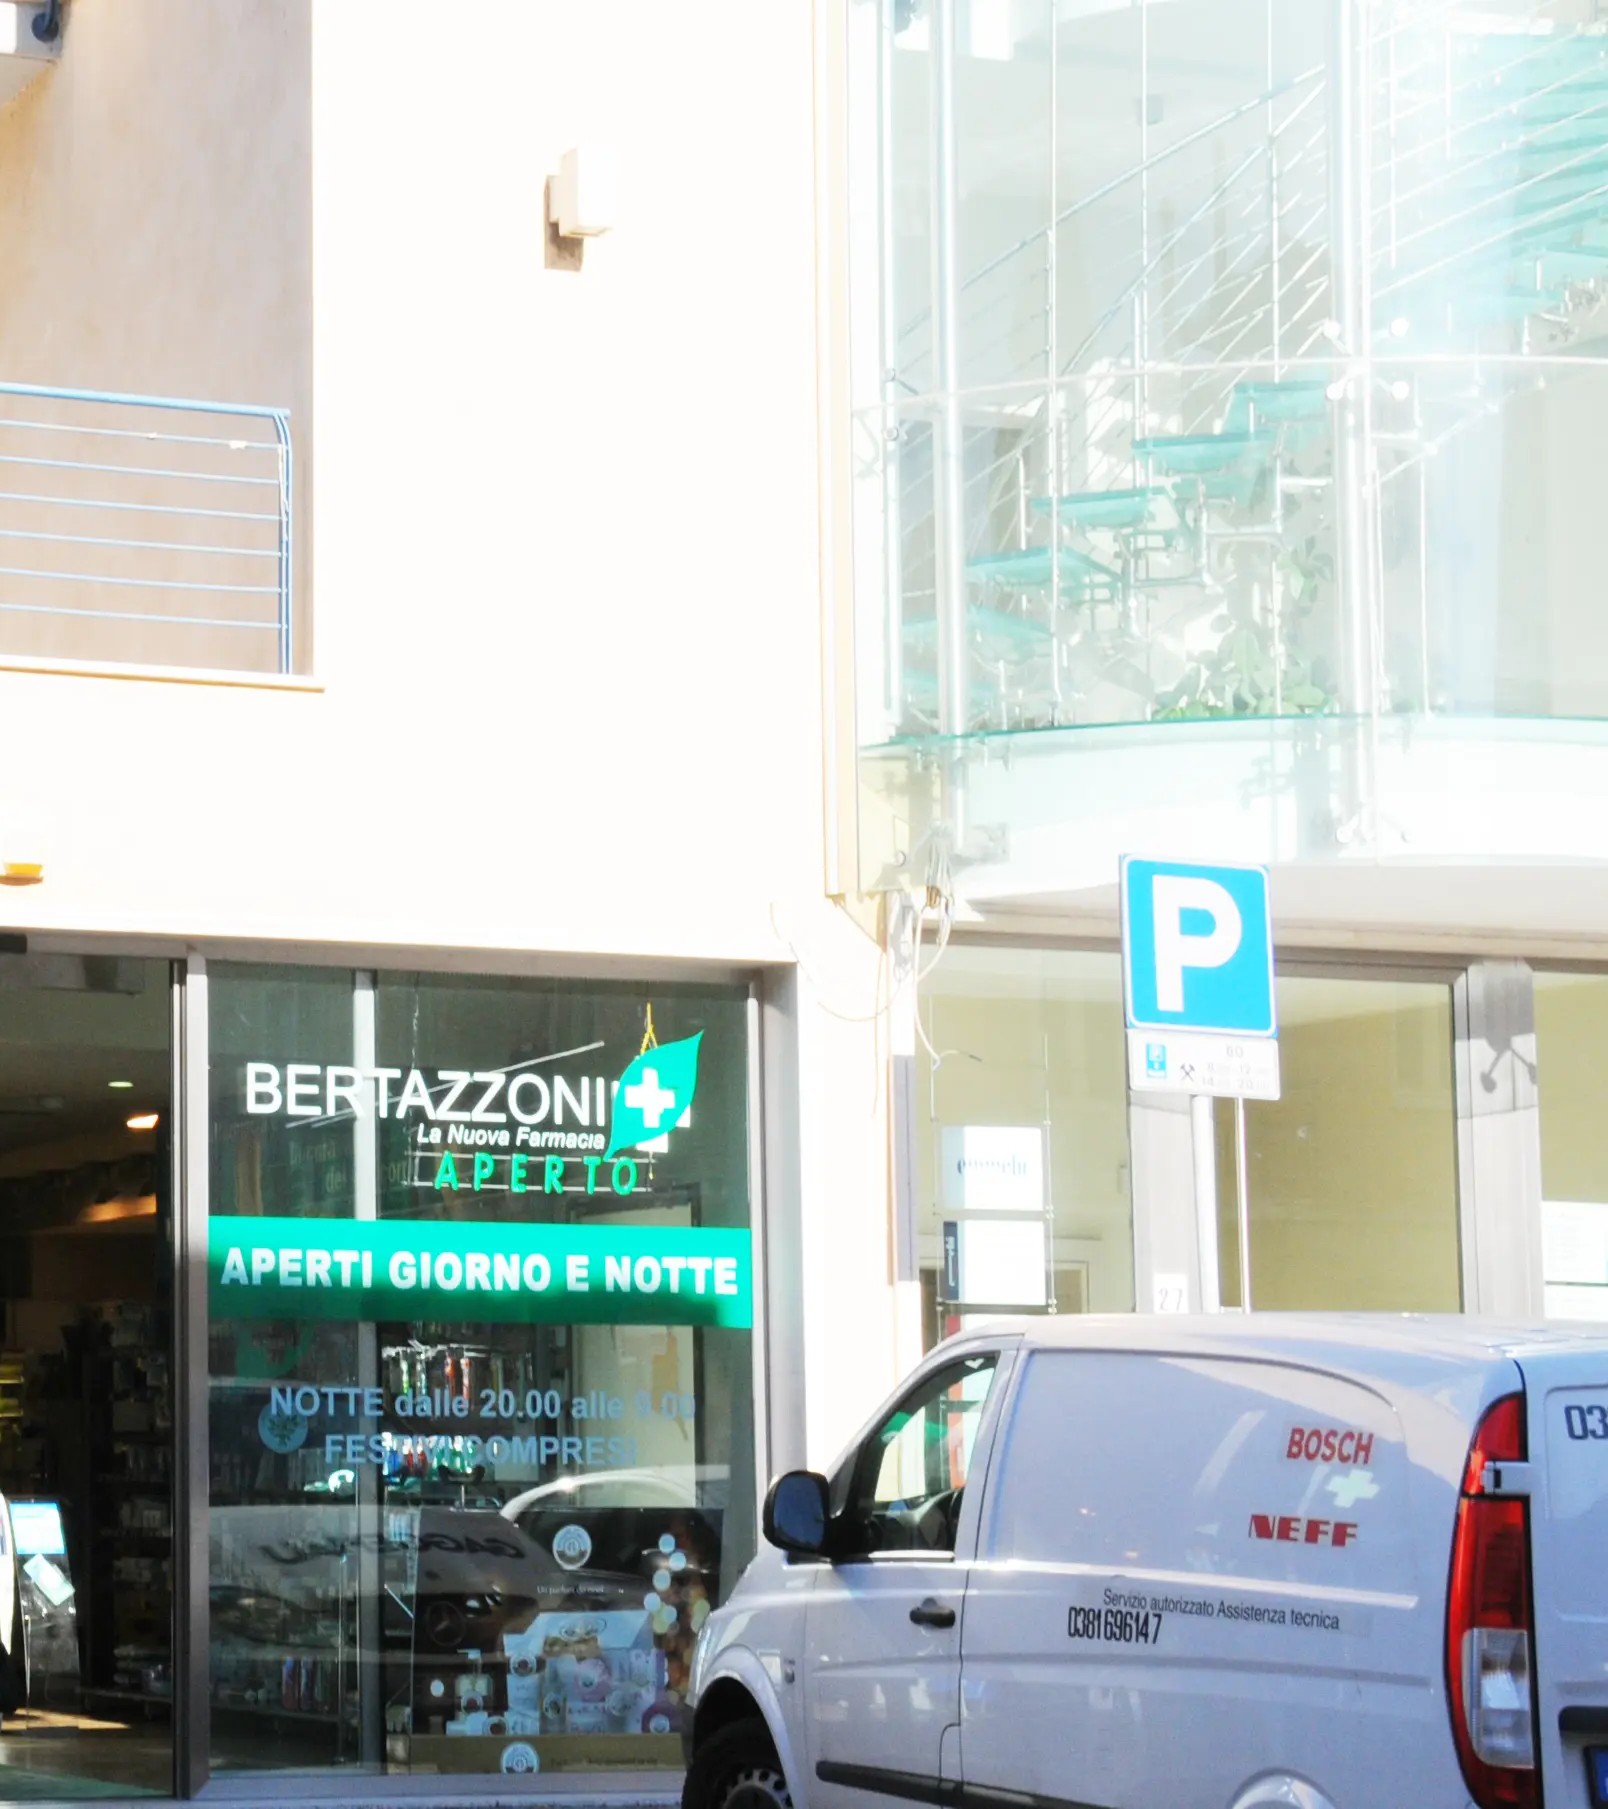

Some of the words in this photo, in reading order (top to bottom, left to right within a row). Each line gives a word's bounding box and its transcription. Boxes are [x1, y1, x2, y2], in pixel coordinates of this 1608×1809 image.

[1152, 874, 1242, 1013] P
[246, 1062, 606, 1127] BERTAZZONI
[417, 1122, 441, 1145] La
[448, 1124, 511, 1147] Nuova
[516, 1126, 605, 1150] Farmacia
[434, 1150, 638, 1195] APERTO
[220, 1246, 373, 1288] APERTI
[389, 1251, 551, 1292] GIORNO
[567, 1256, 590, 1291] E
[605, 1256, 739, 1295] NOTTE
[271, 1386, 385, 1417] NOTTE
[395, 1388, 469, 1418] dalle
[480, 1389, 561, 1419] 20.00
[572, 1390, 623, 1419] alle
[1286, 1427, 1374, 1465] BOSCH
[1248, 1514, 1358, 1547] NEFF
[1104, 1588, 1147, 1610] Servizio
[1150, 1595, 1214, 1617] autorizzato
[1217, 1601, 1286, 1625] Assistenza
[1291, 1610, 1340, 1630] tecnica
